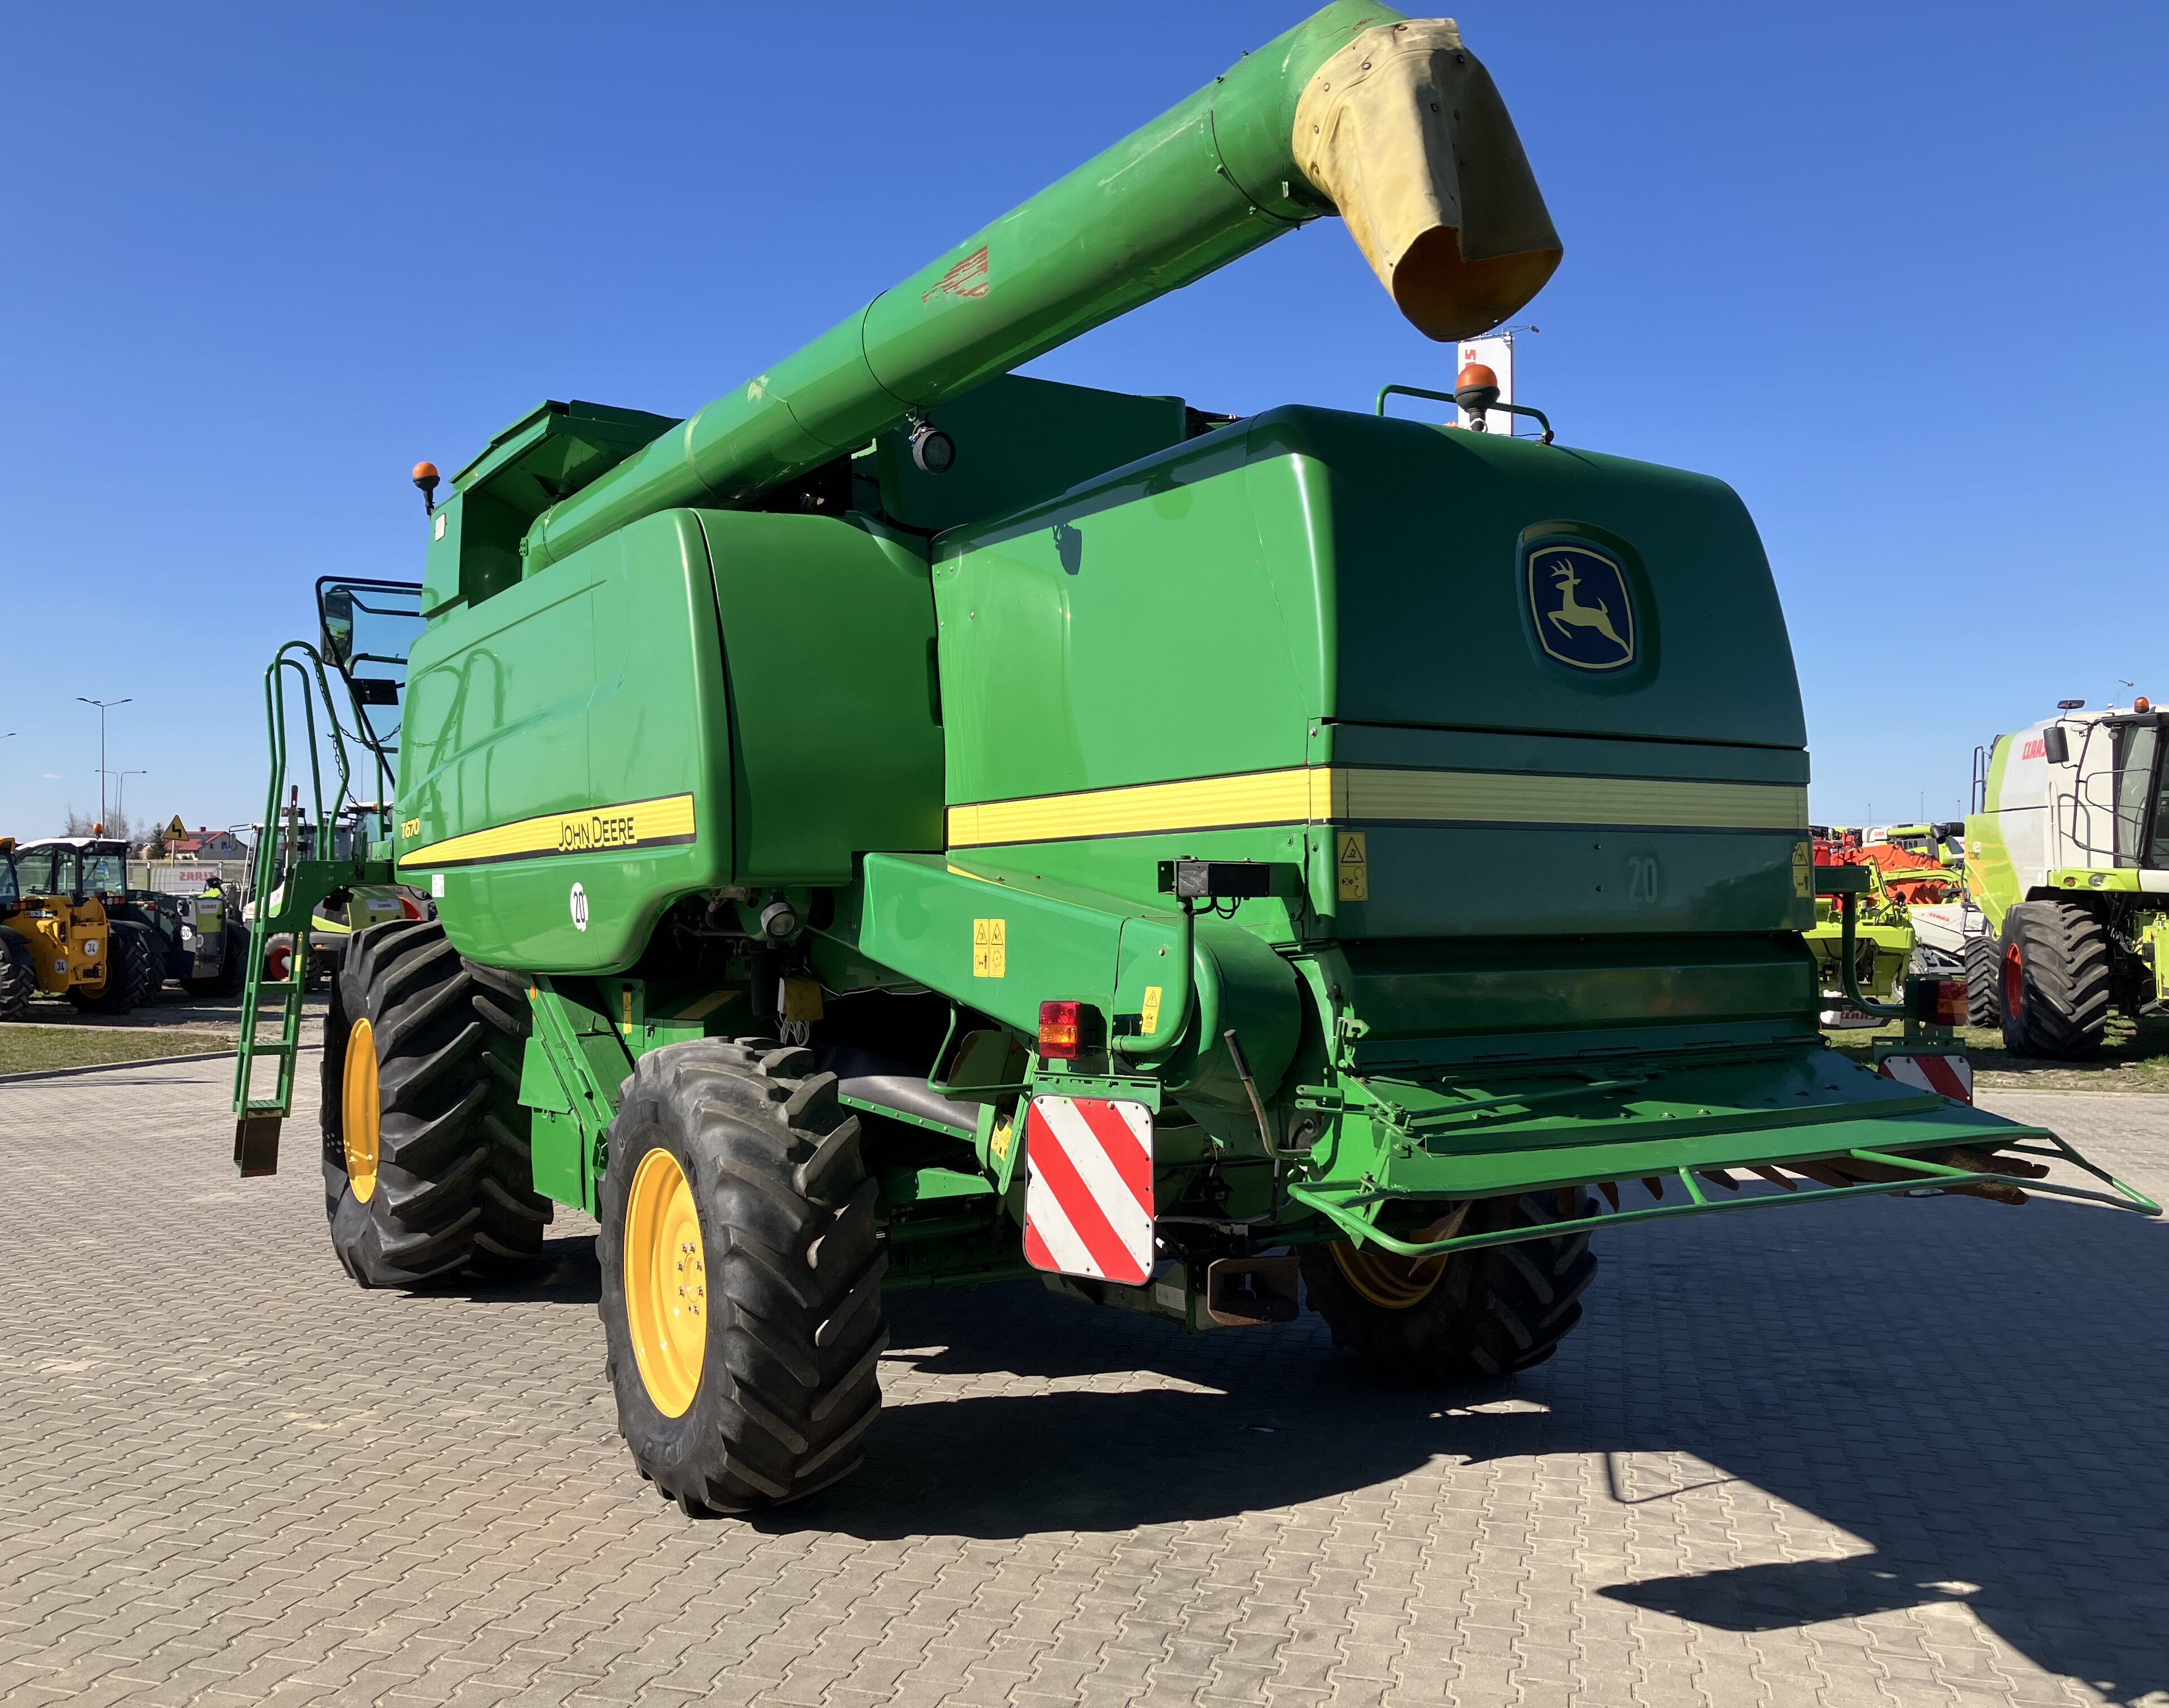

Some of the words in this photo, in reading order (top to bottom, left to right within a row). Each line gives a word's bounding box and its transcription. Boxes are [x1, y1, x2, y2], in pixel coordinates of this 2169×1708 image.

[401, 817, 420, 839] T670
[559, 821, 590, 847] JOHN
[592, 817, 635, 844] DEERE
[1627, 856, 1657, 903] 20
[574, 891, 585, 923] 20
[1930, 912, 1950, 922] CLAAS
[181, 929, 189, 937] 30
[87, 943, 95, 955] 34
